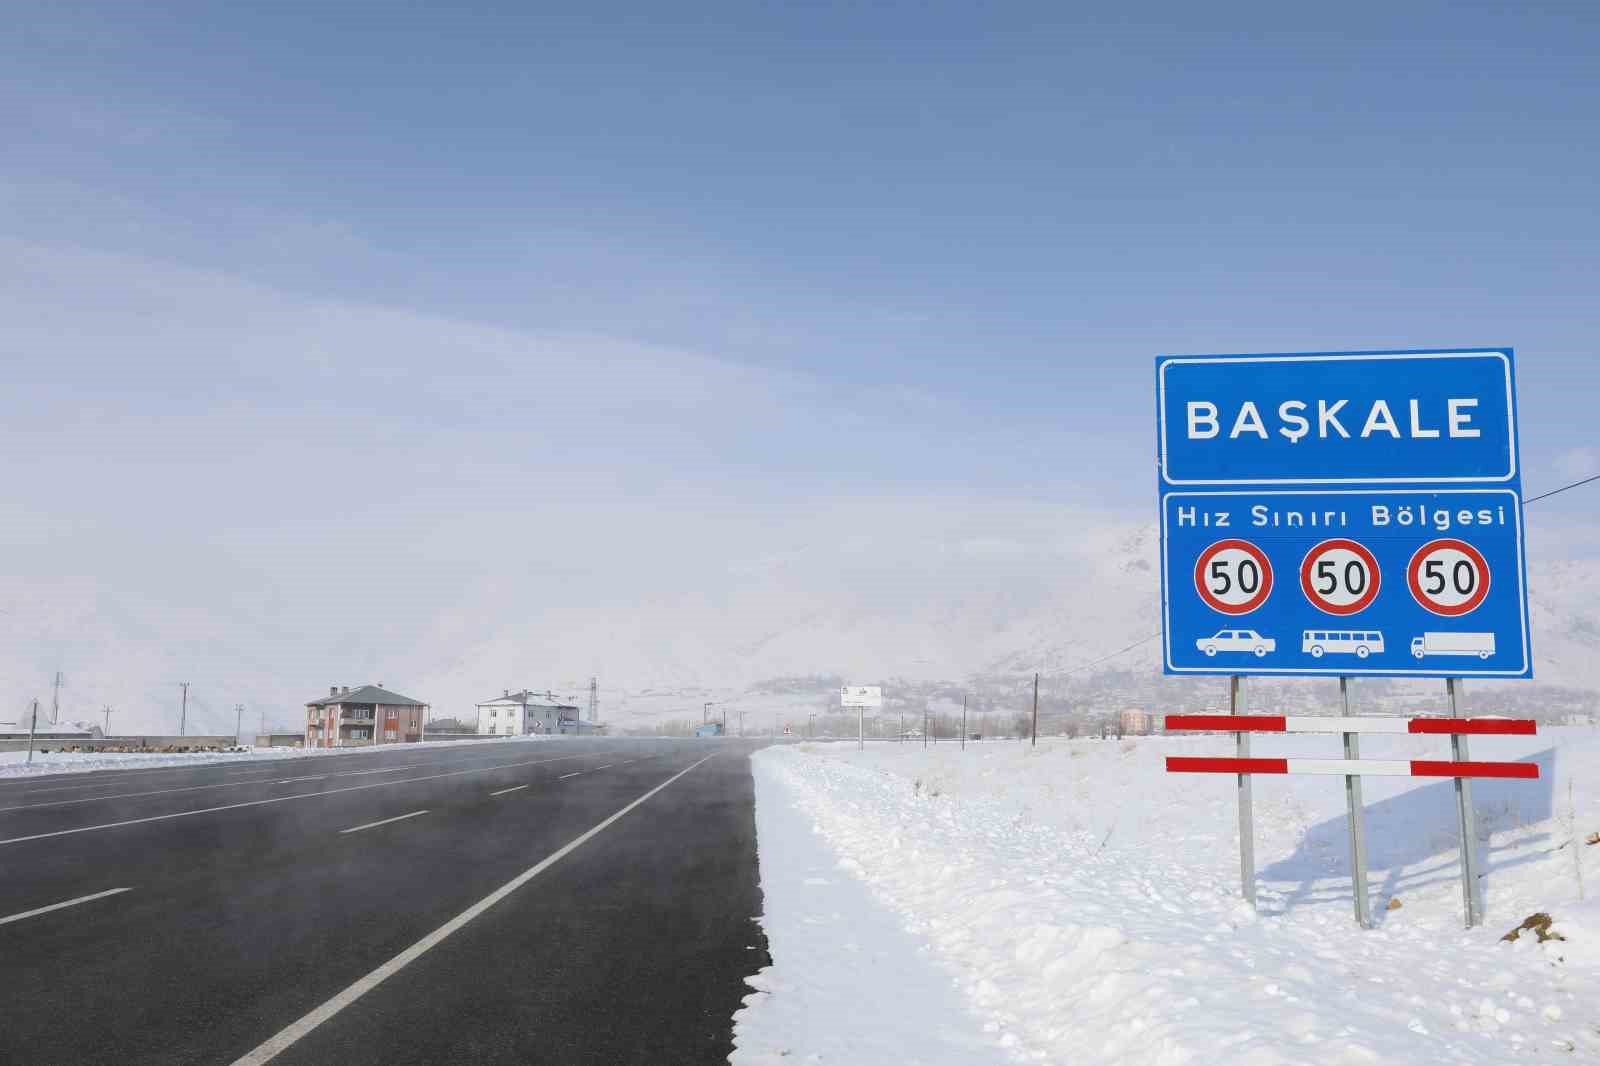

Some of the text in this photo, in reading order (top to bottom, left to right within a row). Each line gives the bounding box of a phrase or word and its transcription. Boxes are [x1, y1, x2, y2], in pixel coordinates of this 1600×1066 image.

[1187, 398, 1481, 444] BAŞKALE
[1178, 506, 1505, 530] Hız Sınırı Bölgesi
[1211, 560, 1259, 595] 50
[1317, 560, 1366, 595] 50
[1425, 560, 1475, 595] 50
